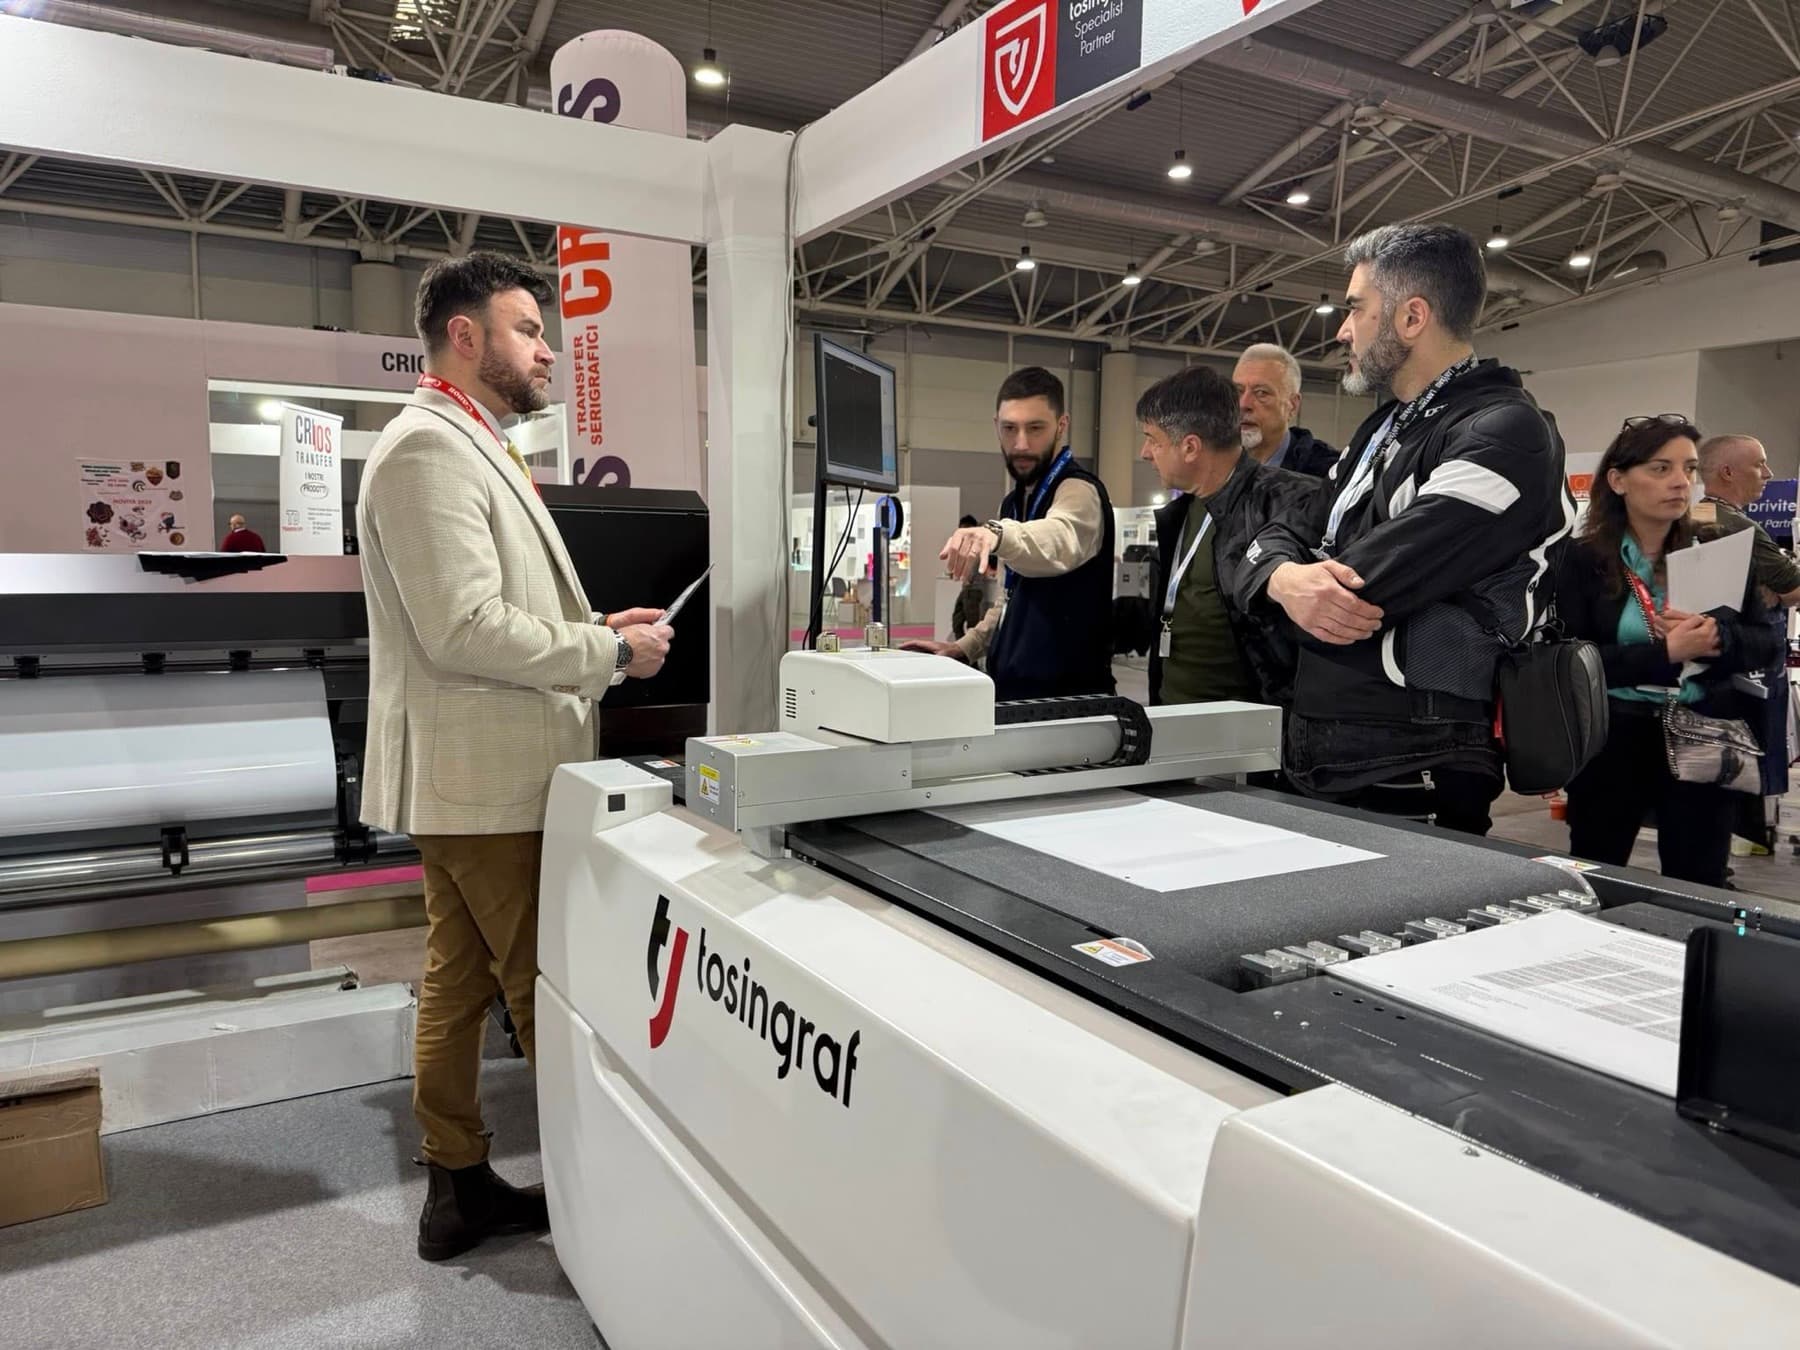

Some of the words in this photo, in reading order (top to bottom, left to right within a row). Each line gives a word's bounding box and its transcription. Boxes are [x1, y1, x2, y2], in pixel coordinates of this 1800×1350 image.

[1069, 0, 1110, 21] tosi
[1074, 0, 1123, 40] Specialist
[1080, 29, 1116, 57] Partner
[573, 334, 587, 436] TRANSFER
[587, 324, 603, 446] SERIGRAFICI
[296, 450, 333, 468] TRANSFER
[697, 926, 861, 1109] tosingraf
